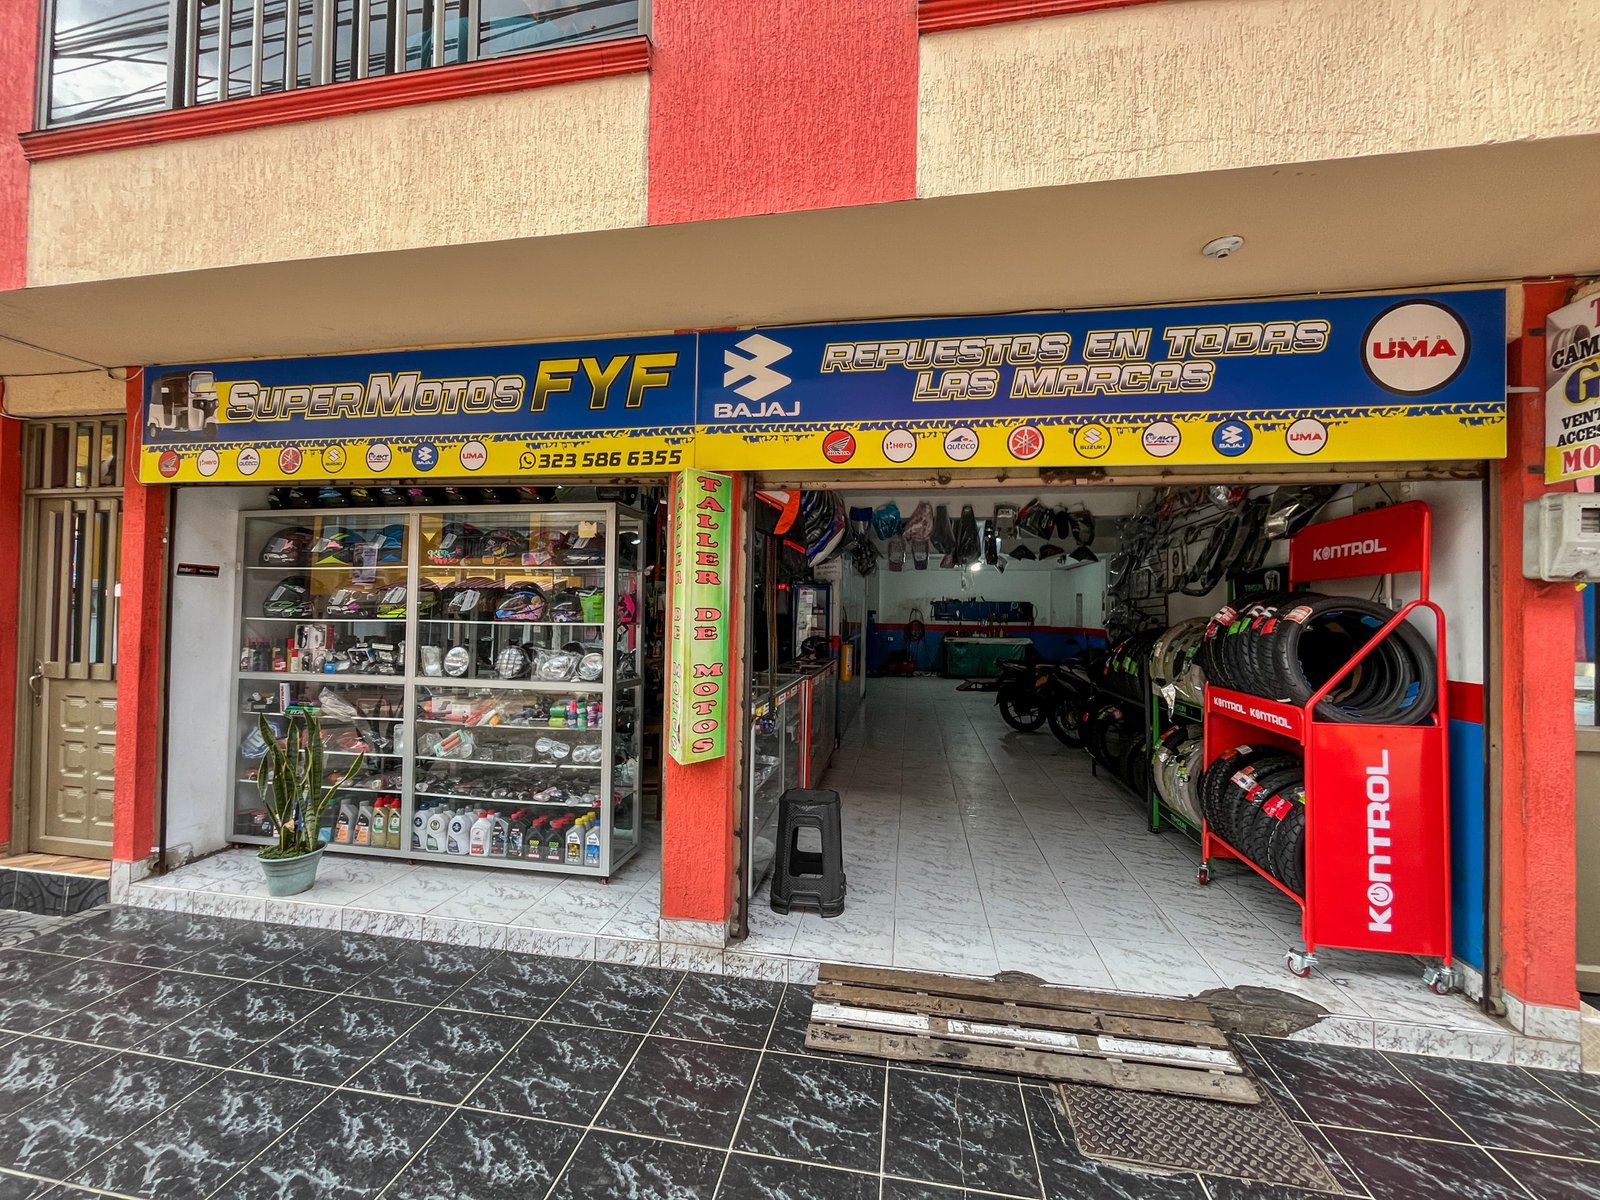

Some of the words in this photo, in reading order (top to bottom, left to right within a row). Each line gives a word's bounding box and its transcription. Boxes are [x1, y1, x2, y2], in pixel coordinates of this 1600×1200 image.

[822, 331, 1071, 373] REPUESTOS
[1083, 327, 1152, 362] EN
[1163, 319, 1331, 359] TODAS
[1373, 339, 1457, 359] UMA
[530, 352, 679, 412] FYF
[913, 368, 1000, 402] LAS
[1010, 360, 1216, 399] MARCAS
[714, 401, 800, 418] BAJAJ
[946, 442, 976, 450] auteco
[1290, 433, 1323, 441] UMA
[538, 454, 579, 469] 323
[582, 452, 621, 467] 586
[627, 450, 683, 466] 6355
[695, 476, 725, 585] TALLER
[1313, 538, 1387, 561] KONTROL
[694, 608, 721, 640] DE
[692, 663, 723, 753] MOTOS
[1213, 696, 1246, 715] KONTROL
[1249, 707, 1293, 730] KONTROL
[1366, 749, 1394, 933] KONTROL
